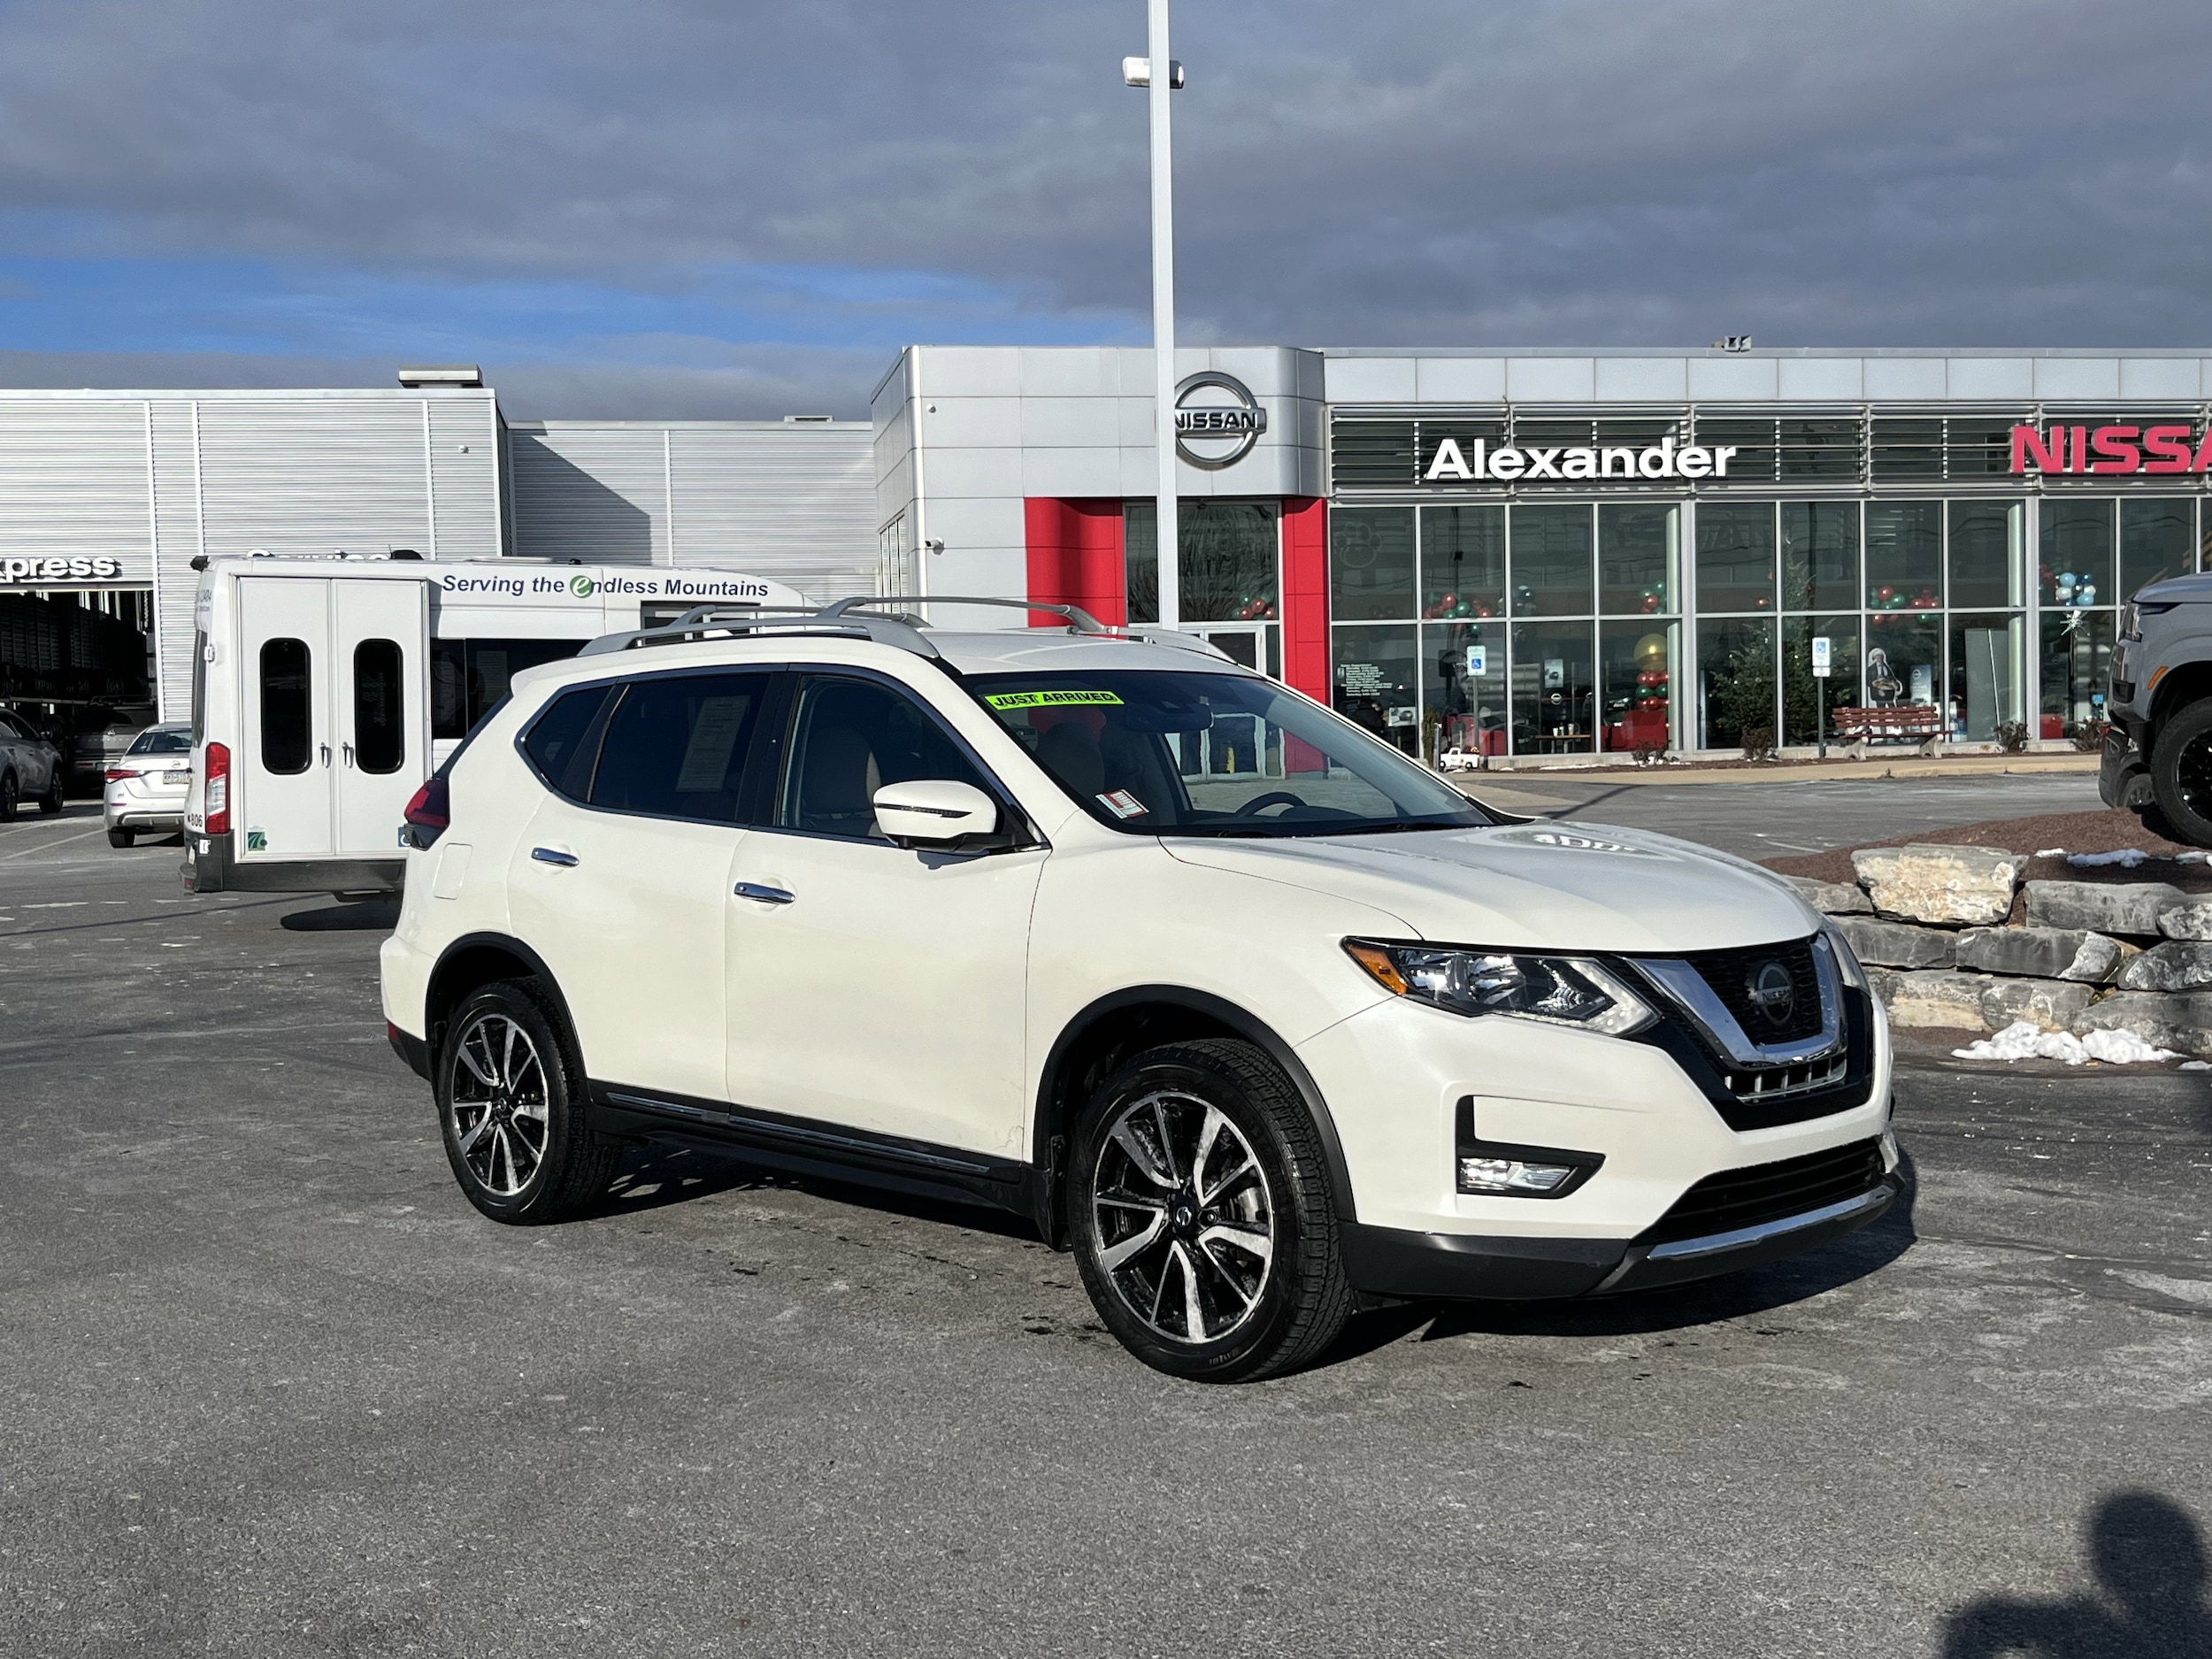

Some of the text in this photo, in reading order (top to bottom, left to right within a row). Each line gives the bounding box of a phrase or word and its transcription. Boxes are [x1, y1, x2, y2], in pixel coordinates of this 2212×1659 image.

[1175, 412, 1257, 429] NISSAN
[1425, 437, 1737, 480] Alexander
[0, 557, 116, 583] press
[442, 575, 525, 596] Serving
[532, 576, 565, 593] the
[664, 579, 769, 596] Mountains
[994, 693, 1117, 707] JUST ARRIVED
